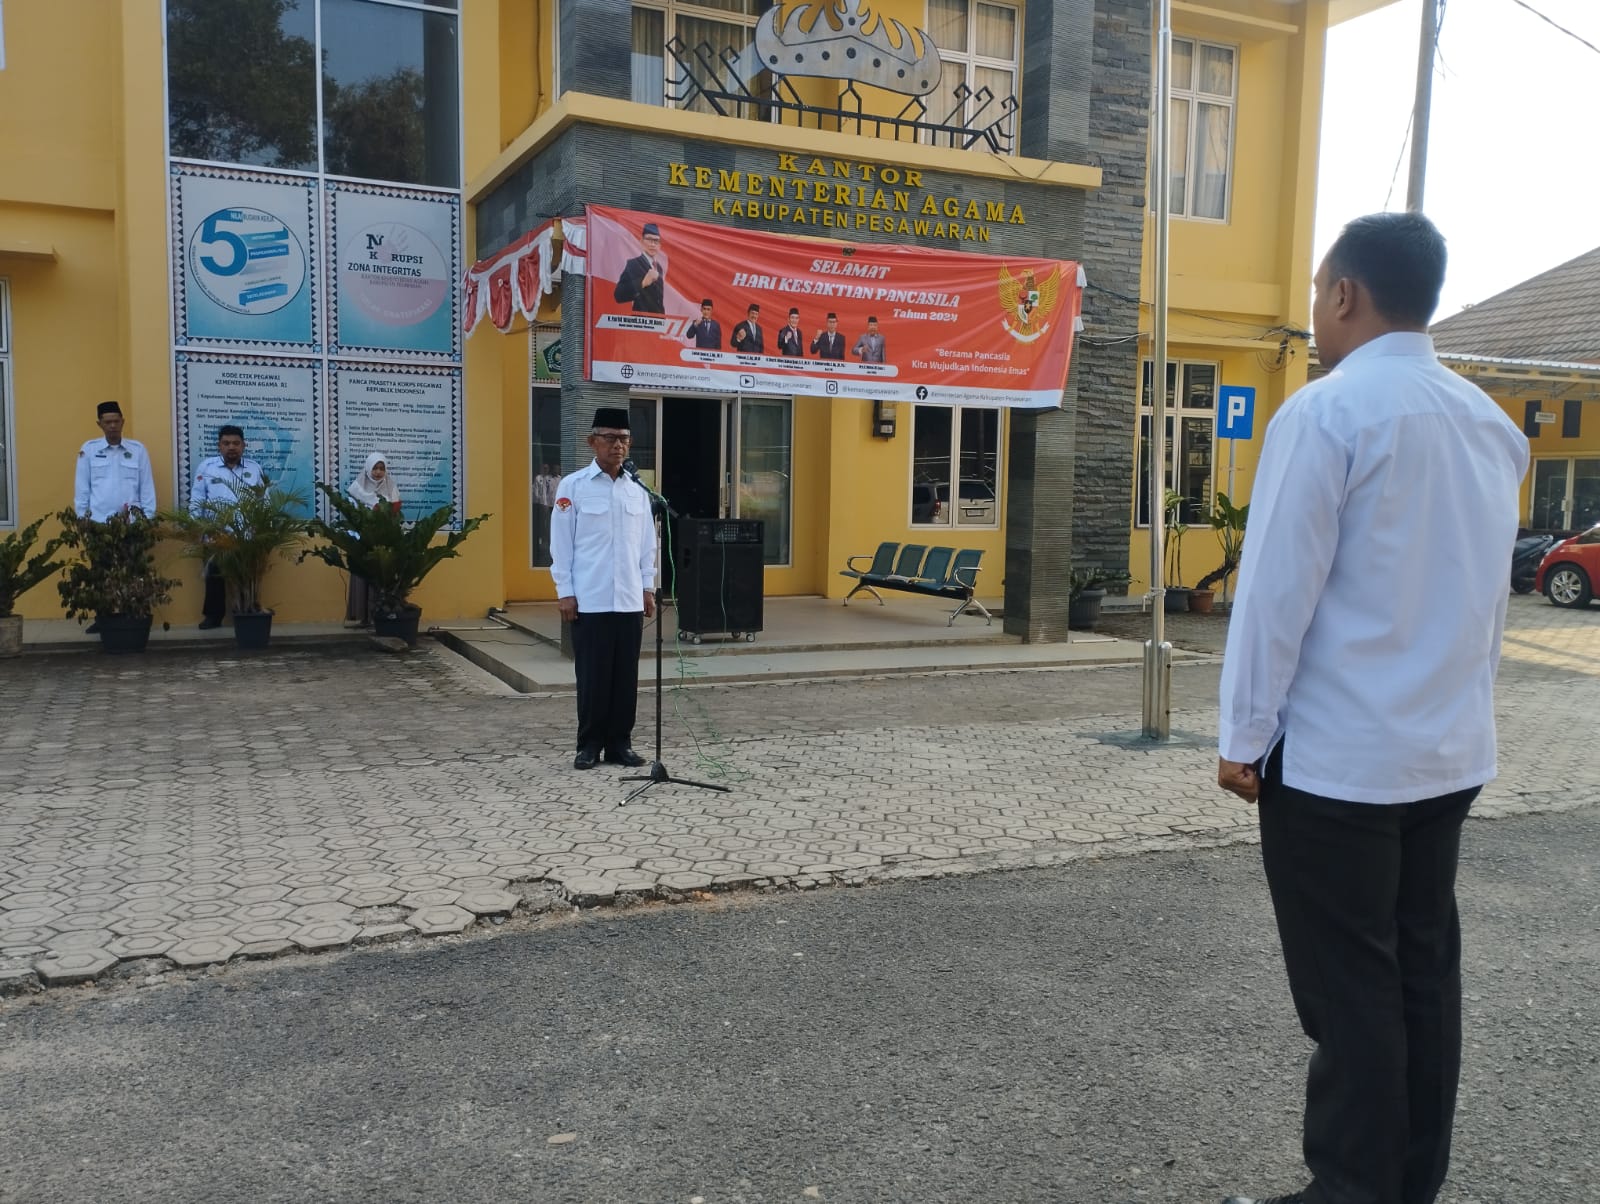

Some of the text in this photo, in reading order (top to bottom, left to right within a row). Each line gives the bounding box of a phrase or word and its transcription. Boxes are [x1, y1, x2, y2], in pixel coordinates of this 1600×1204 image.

[777, 153, 924, 188] KANTOR
[668, 162, 1026, 225] KEMENTERIAN AGAMA
[712, 197, 991, 242] KABUPATEN PESAWARAN
[200, 208, 248, 277] 5
[347, 262, 422, 277] ZONA INTEGRITAS
[808, 258, 892, 280] SELAMAT
[732, 272, 961, 308] HARI KESAKTIAN PANCASILA
[892, 308, 959, 323] Tahun 2024
[911, 359, 929, 370] Kita
[929, 360, 970, 374] Wujudkan
[971, 363, 1007, 375] Indonesia
[974, 350, 1011, 362] Pancasila
[215, 379, 257, 387] KEMENTERIAN
[253, 373, 281, 381] PEGAWAI
[1227, 396, 1246, 429] P
